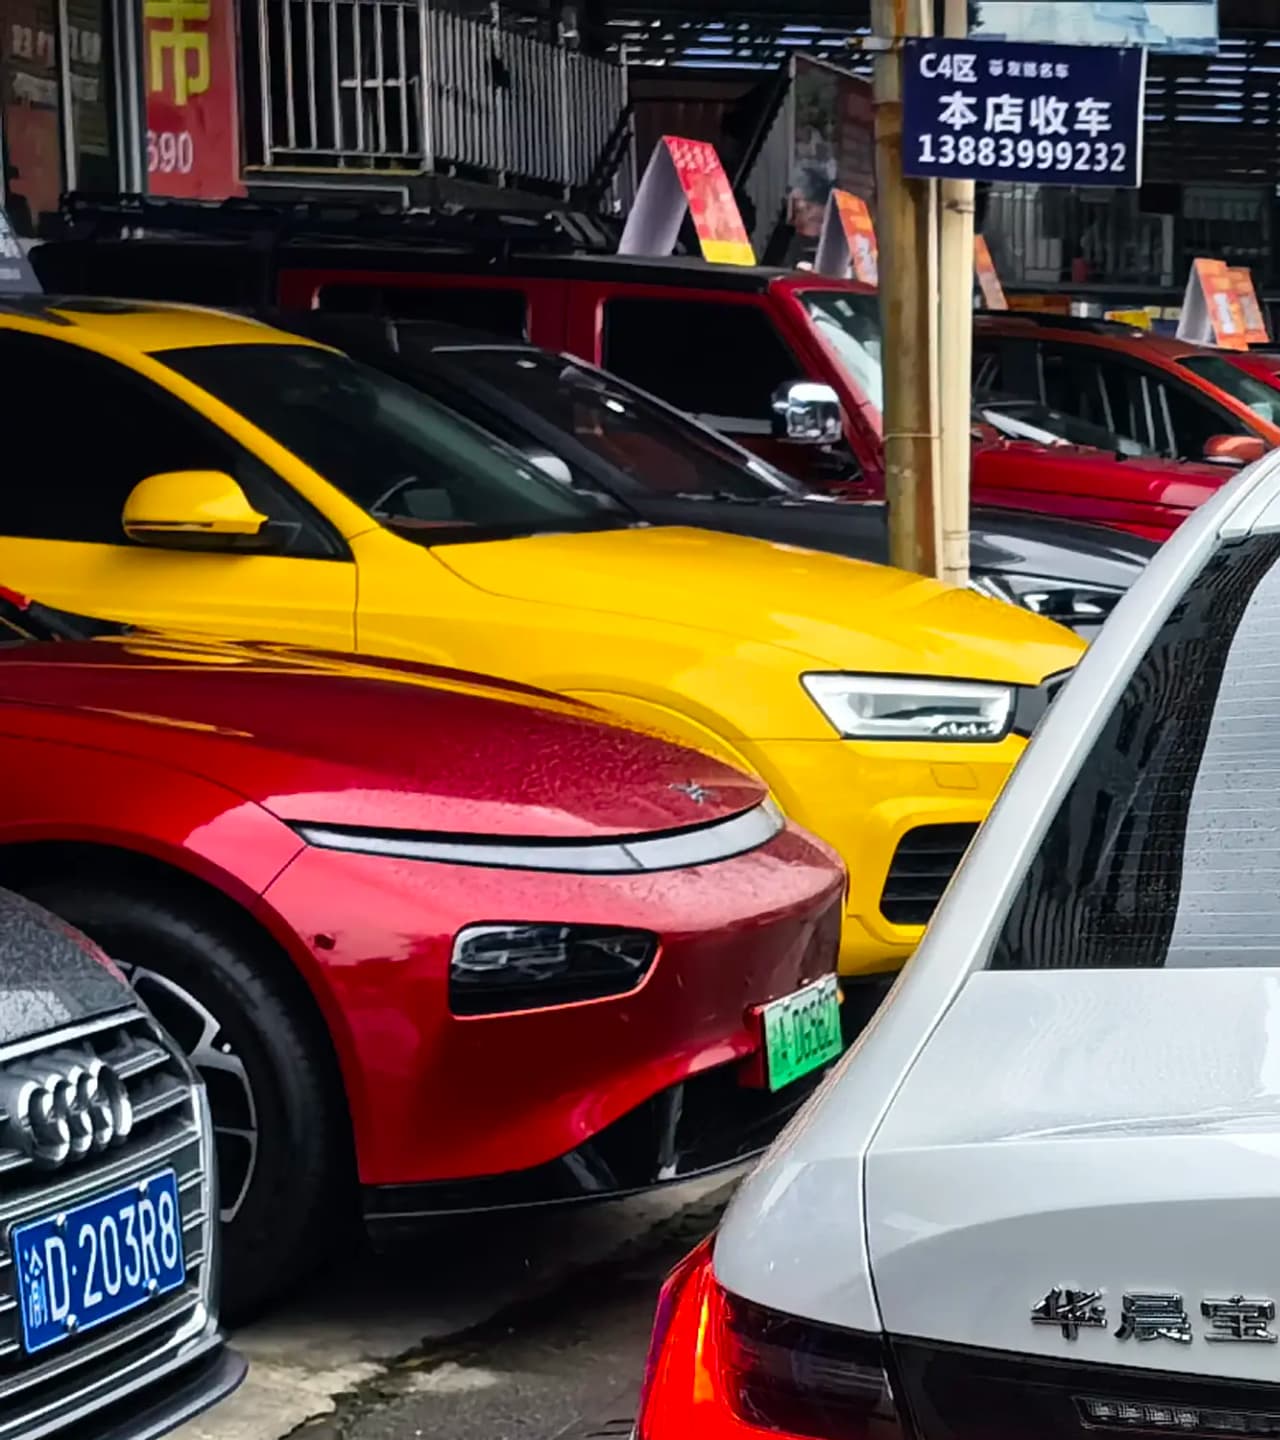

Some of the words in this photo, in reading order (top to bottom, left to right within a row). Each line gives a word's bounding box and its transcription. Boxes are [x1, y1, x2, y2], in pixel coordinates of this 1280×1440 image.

[919, 52, 978, 82] C4区
[937, 90, 1112, 138] 本店收车
[918, 132, 1127, 172] 13883999232
